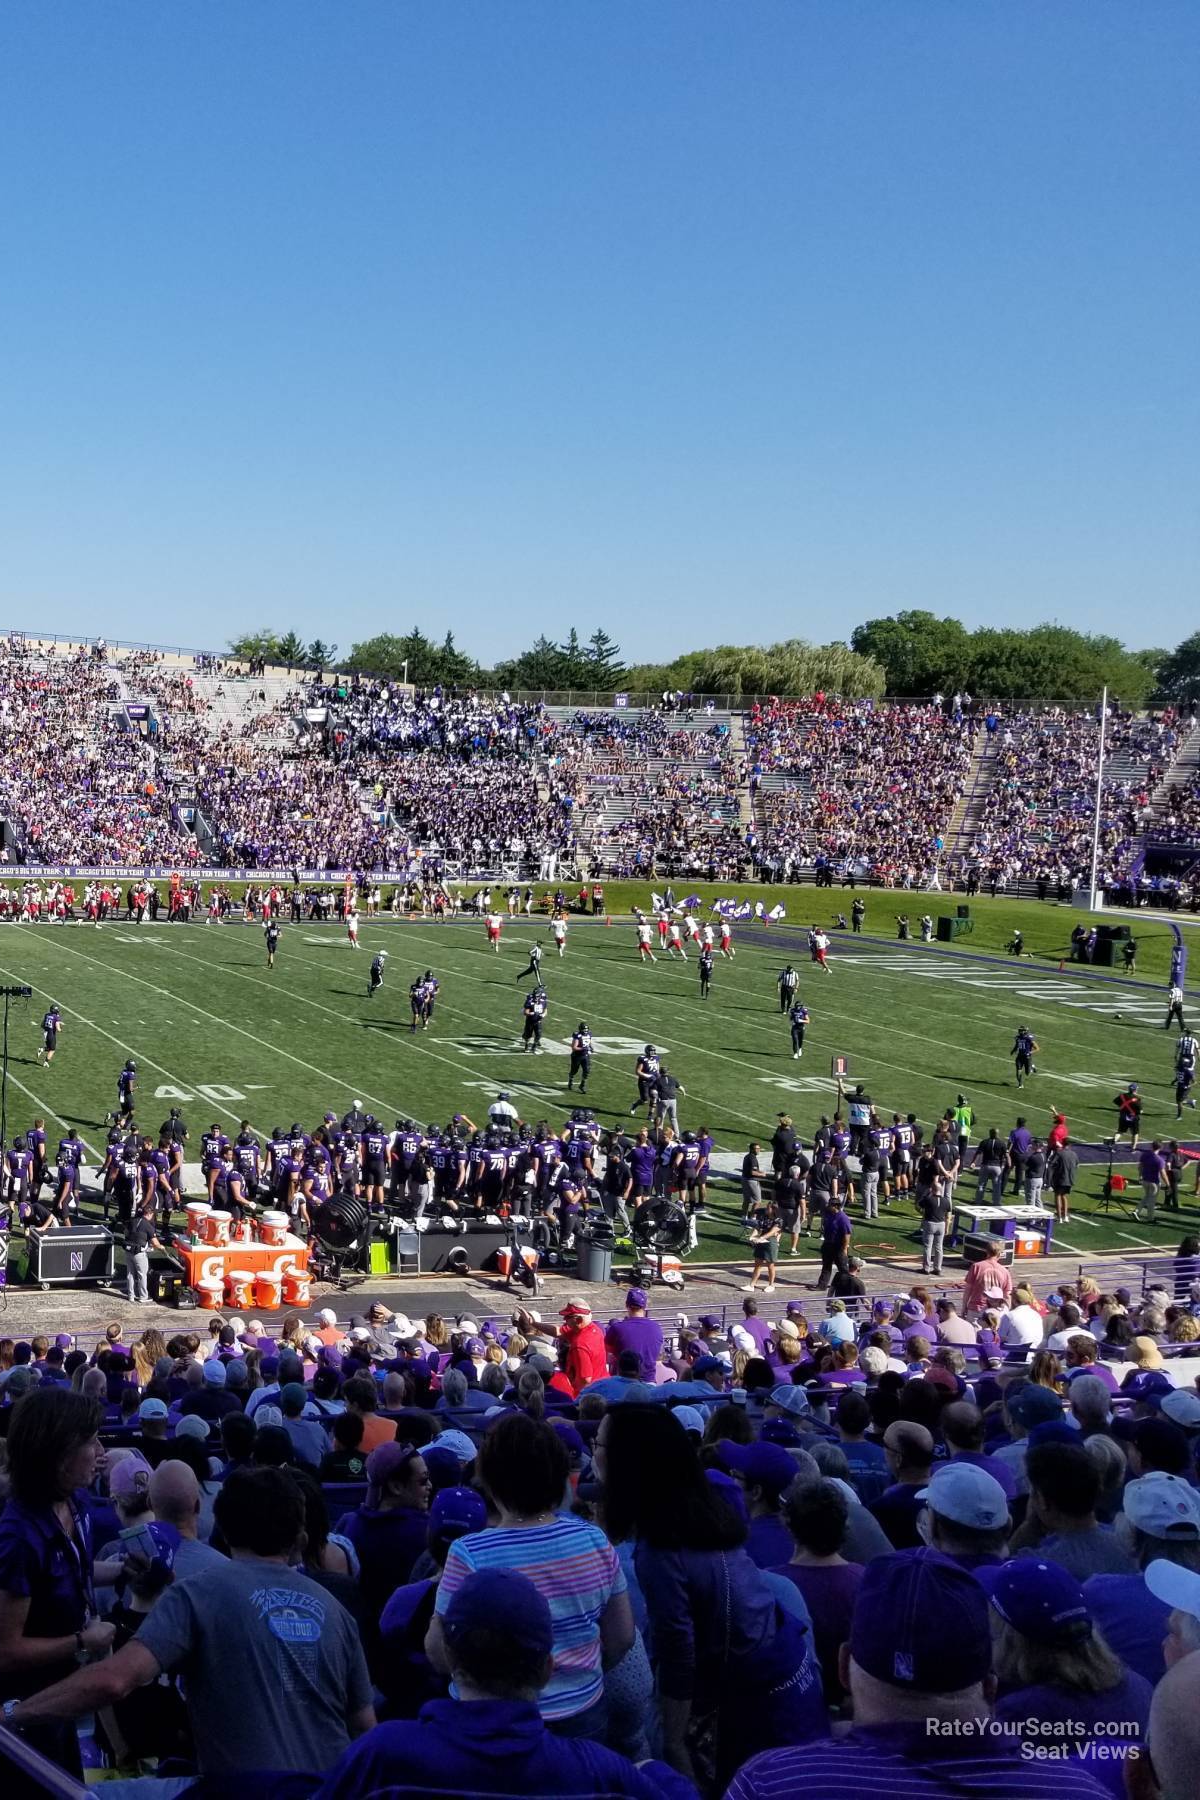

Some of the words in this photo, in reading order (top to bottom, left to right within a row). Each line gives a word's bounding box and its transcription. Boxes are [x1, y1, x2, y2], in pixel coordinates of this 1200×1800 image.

[616, 698, 626, 706] 113
[64, 868, 70, 876] N
[149, 869, 156, 877] N
[320, 872, 326, 880] N
[1171, 950, 1182, 963] N
[154, 1084, 247, 1100] 40
[880, 1138, 890, 1149] 16
[901, 1133, 910, 1144] 13
[368, 1142, 382, 1154] 87
[402, 1142, 417, 1153] 86
[567, 1146, 577, 1157] 79
[432, 1155, 445, 1167] 39
[490, 1158, 504, 1170] 78
[125, 1168, 137, 1178] 69
[1025, 1241, 1034, 1250] G
[70, 1251, 83, 1270] N
[202, 1256, 224, 1280] G
[290, 1624, 312, 1636] TOUR
